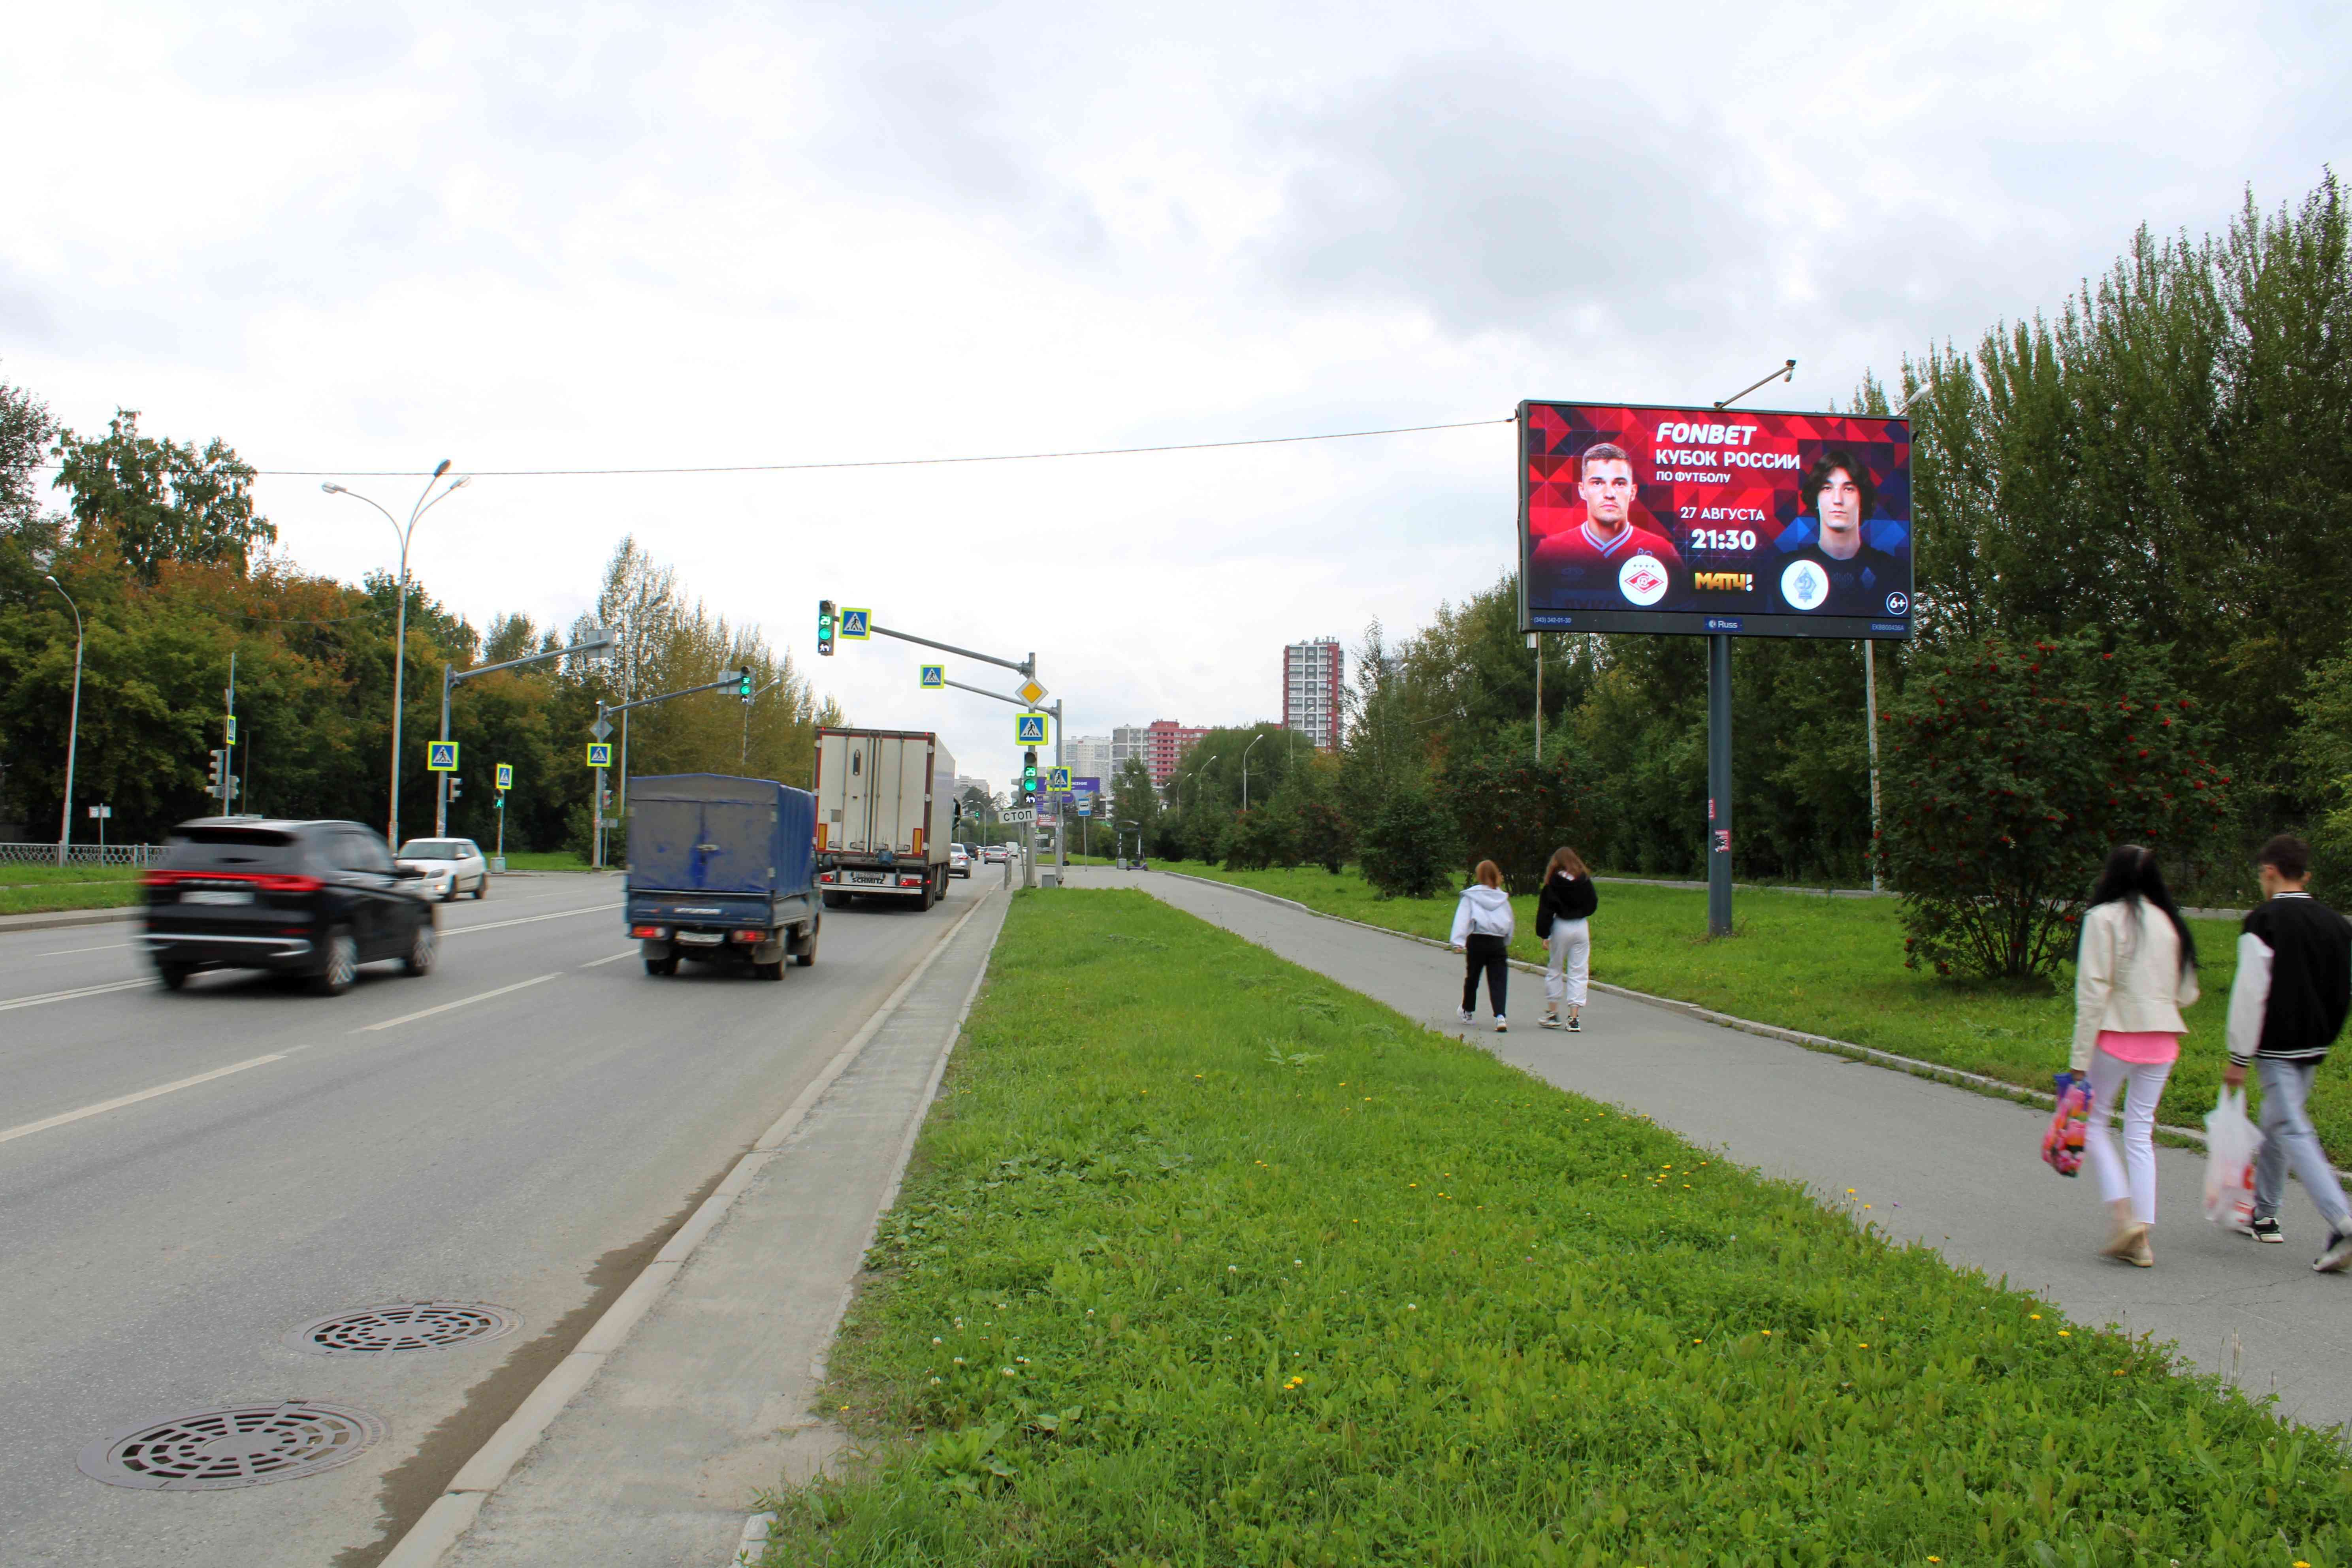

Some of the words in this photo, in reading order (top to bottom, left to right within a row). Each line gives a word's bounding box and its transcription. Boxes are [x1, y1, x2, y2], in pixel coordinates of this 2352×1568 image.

[1656, 422, 1757, 446] FONBET
[1656, 449, 1717, 467] КУБОК
[1724, 452, 1801, 470] РОССИИ
[1656, 471, 1672, 481] ПО
[1674, 471, 1731, 483] ФУТБОЛУ
[1680, 506, 1697, 519] 27
[1700, 507, 1766, 521] АВГУСТА
[1691, 528, 1757, 550] 21:30
[1694, 572, 1753, 592] МАТЧ!
[1890, 597, 1906, 609] 6+
[1004, 810, 1032, 822] СТОП
